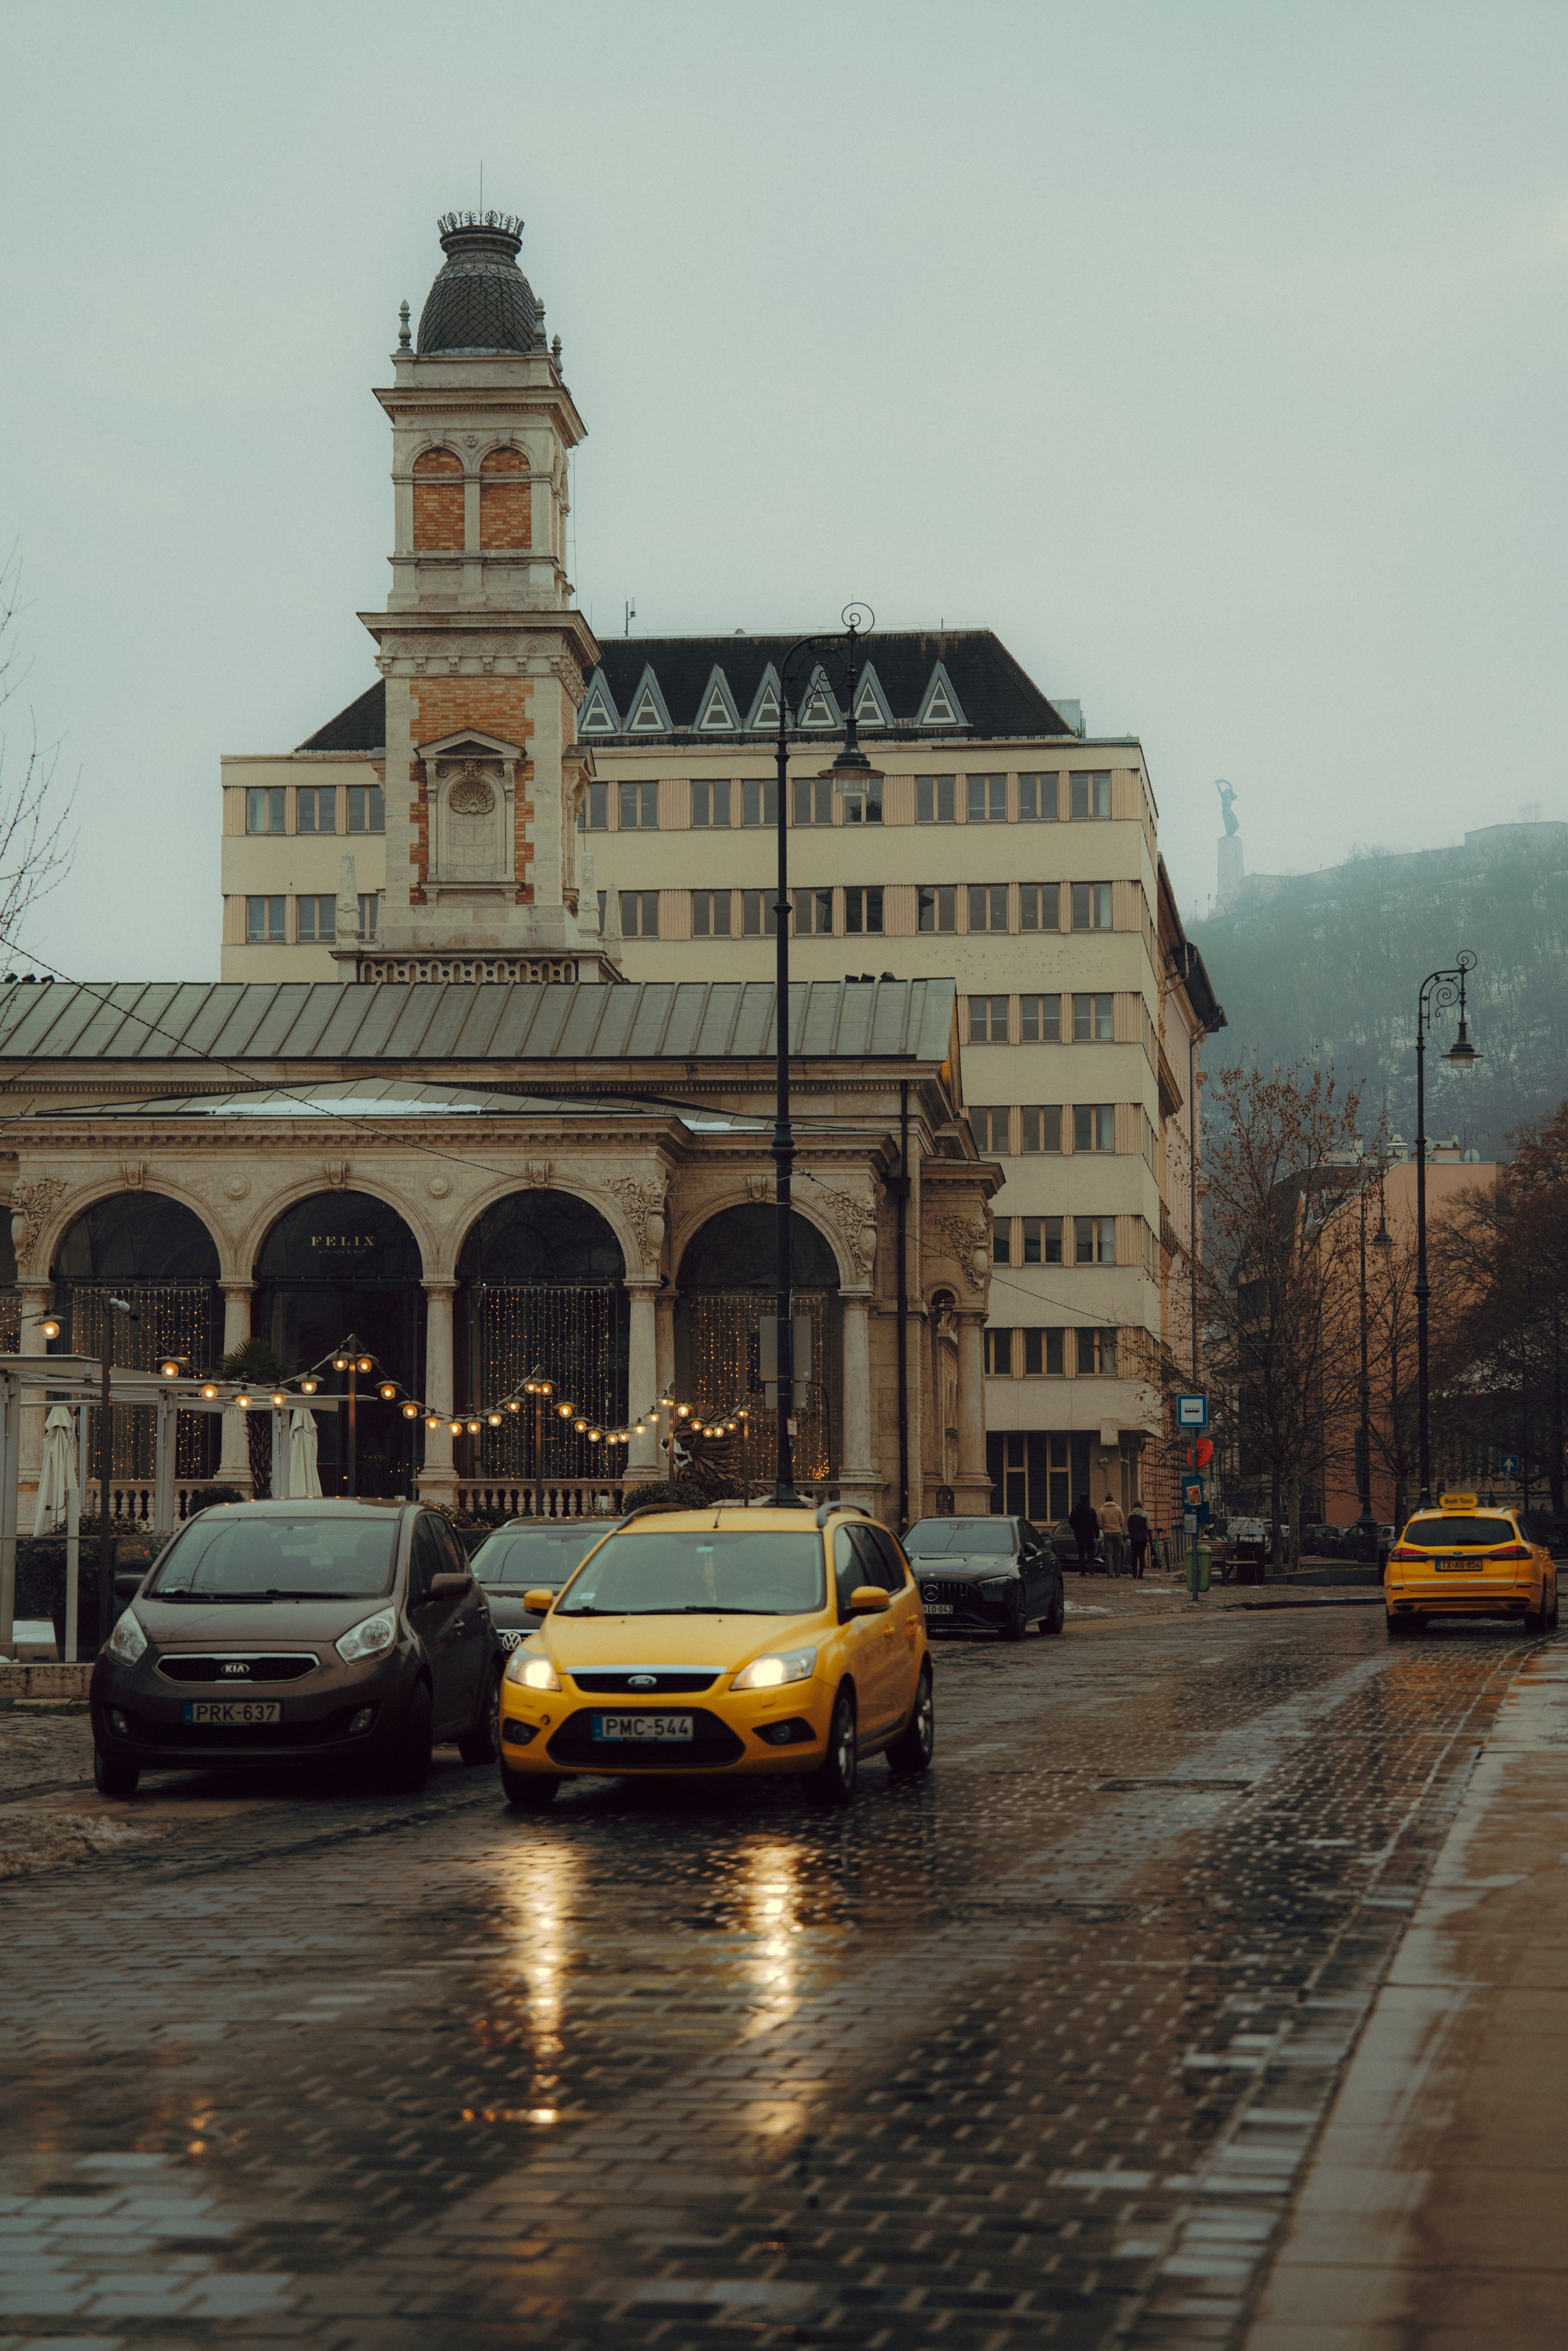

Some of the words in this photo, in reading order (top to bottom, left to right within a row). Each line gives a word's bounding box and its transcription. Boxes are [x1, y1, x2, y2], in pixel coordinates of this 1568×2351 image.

[311, 1236, 375, 1246] FELIX
[197, 1705, 276, 1721] PRK-637
[606, 1719, 688, 1735] PMC-544
